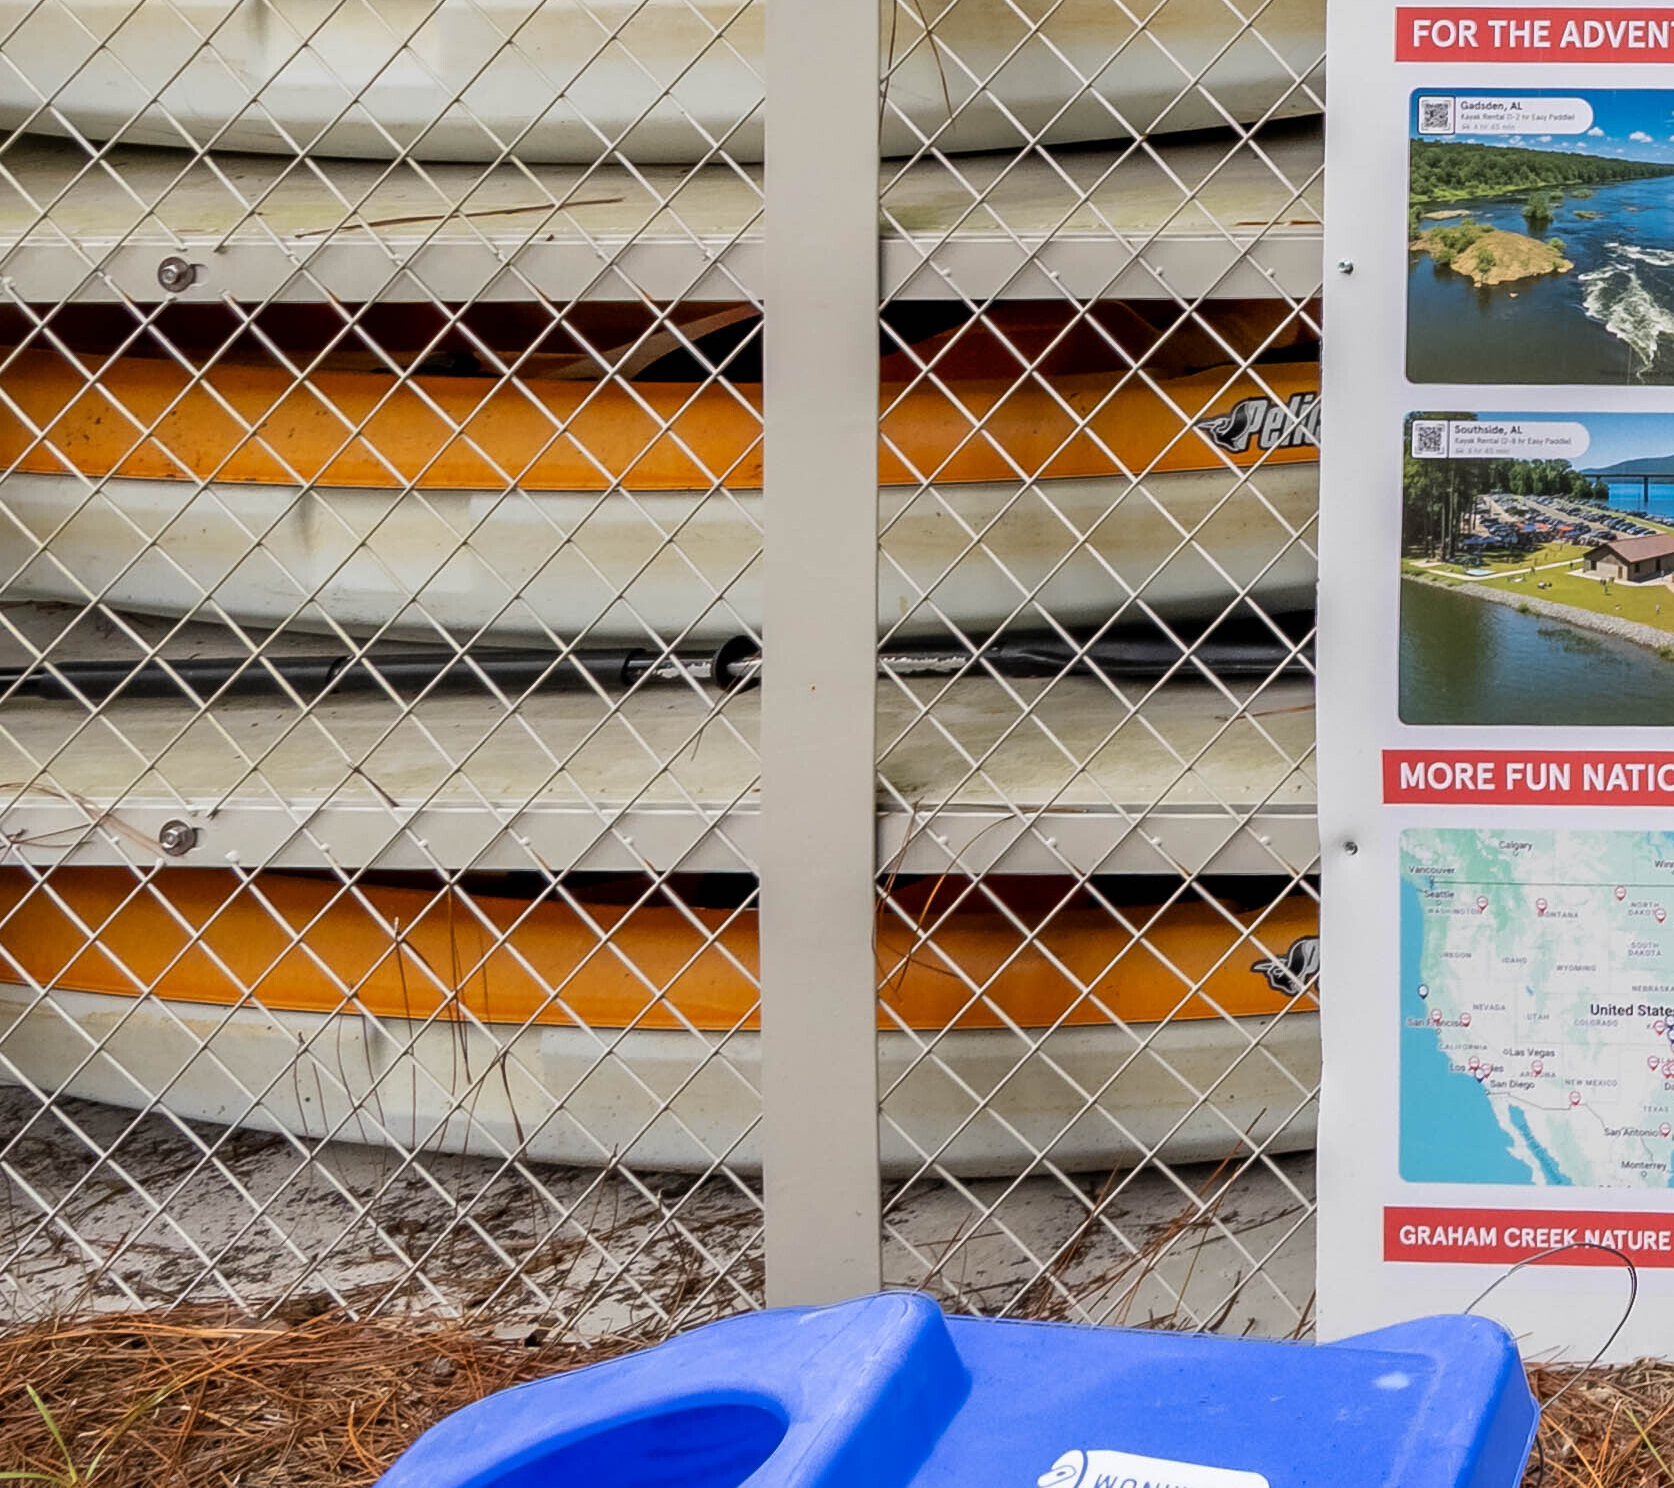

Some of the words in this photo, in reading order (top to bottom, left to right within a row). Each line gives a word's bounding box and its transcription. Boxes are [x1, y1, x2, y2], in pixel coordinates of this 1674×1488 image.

[1412, 20, 1478, 47] FOR
[1488, 21, 1551, 48] THE
[1461, 102, 1507, 111] Gadsden,
[1455, 425, 1508, 435] Southside,
[1510, 426, 1522, 434] AL
[1401, 762, 1494, 790] MORE
[1506, 763, 1570, 791] FUN
[1591, 1004, 1633, 1016] United
[1510, 1049, 1526, 1057] Las
[1528, 1049, 1554, 1058] Vegas
[1621, 1161, 1666, 1171] Monterrey
[1400, 1226, 1497, 1247] GRAHAM
[1504, 1227, 1575, 1249] CREEK
[1585, 1229, 1670, 1251] NATURE
